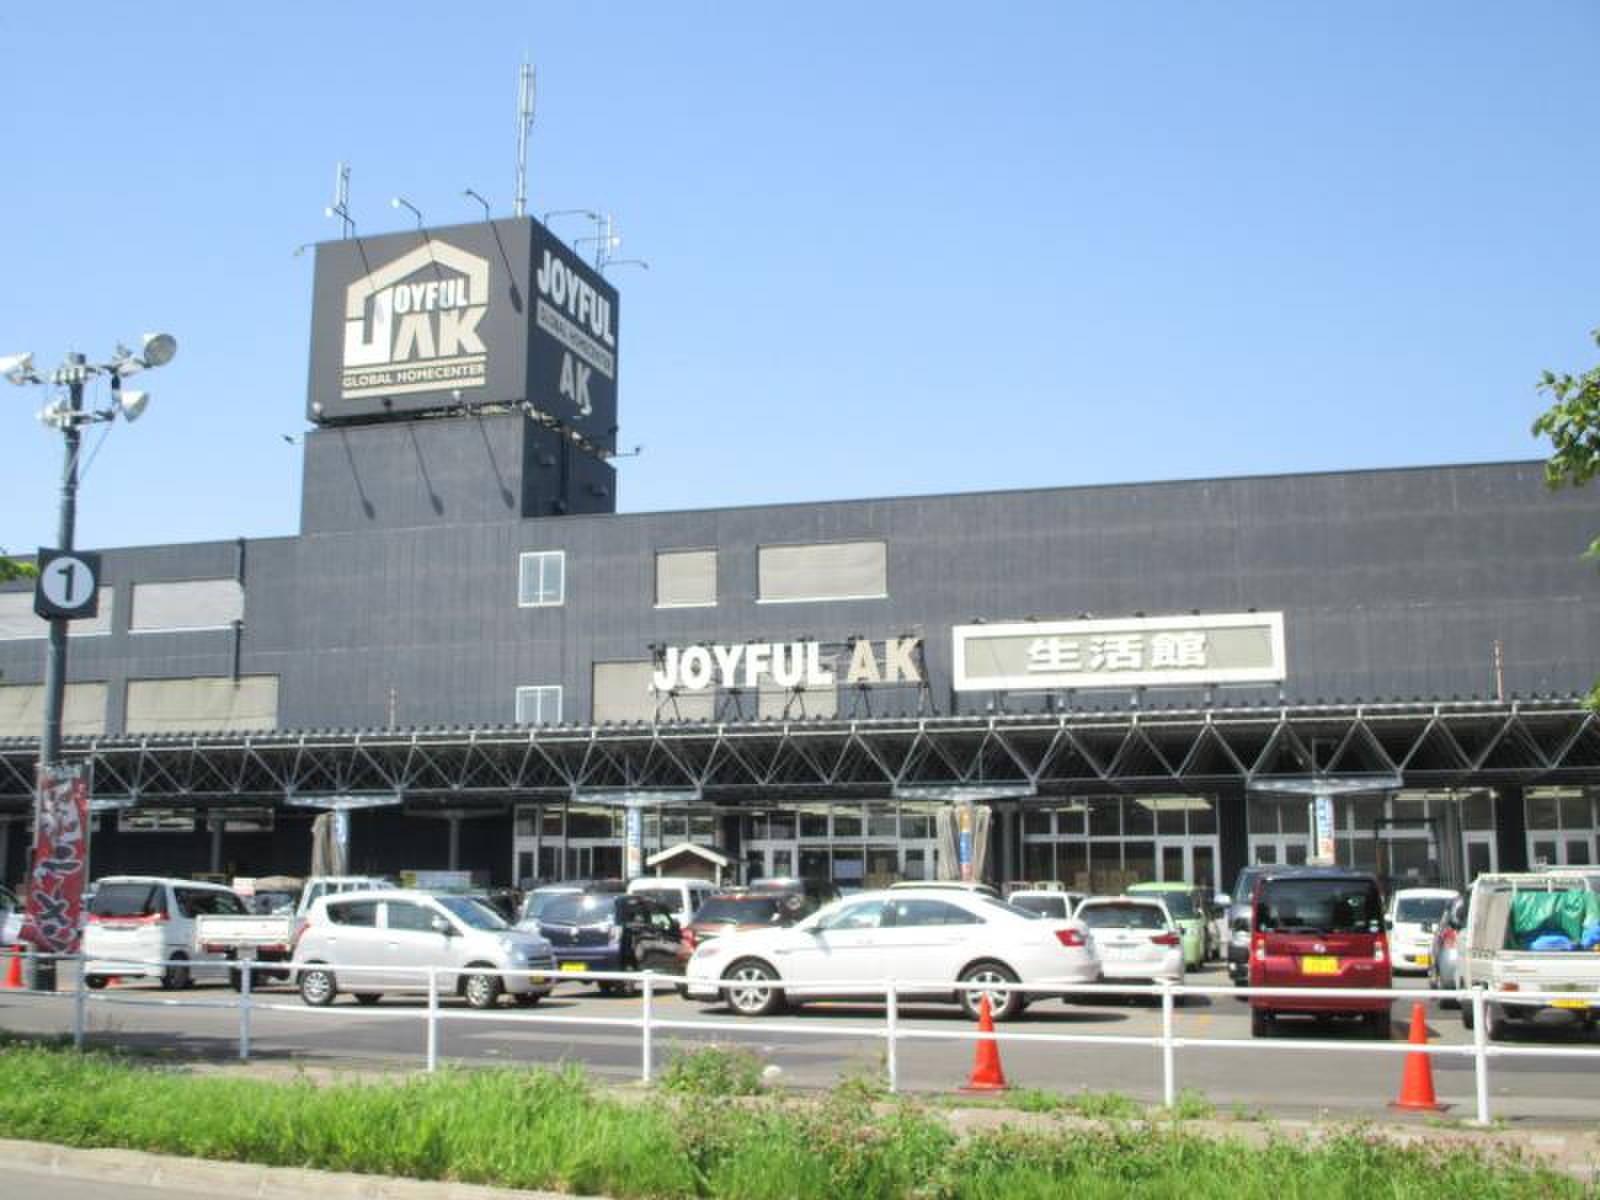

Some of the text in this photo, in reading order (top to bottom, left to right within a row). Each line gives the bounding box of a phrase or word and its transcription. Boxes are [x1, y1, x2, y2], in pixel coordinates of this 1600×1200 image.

[343, 279, 469, 367] JOYFUL
[537, 249, 615, 347] JOYFUL
[392, 307, 487, 360] AK
[342, 364, 486, 387] GLOBAL HOMECENTER
[560, 351, 592, 407] AK
[57, 563, 75, 602] 1
[653, 638, 922, 691] JOYFUL AK
[1027, 632, 1207, 672] 生活館
